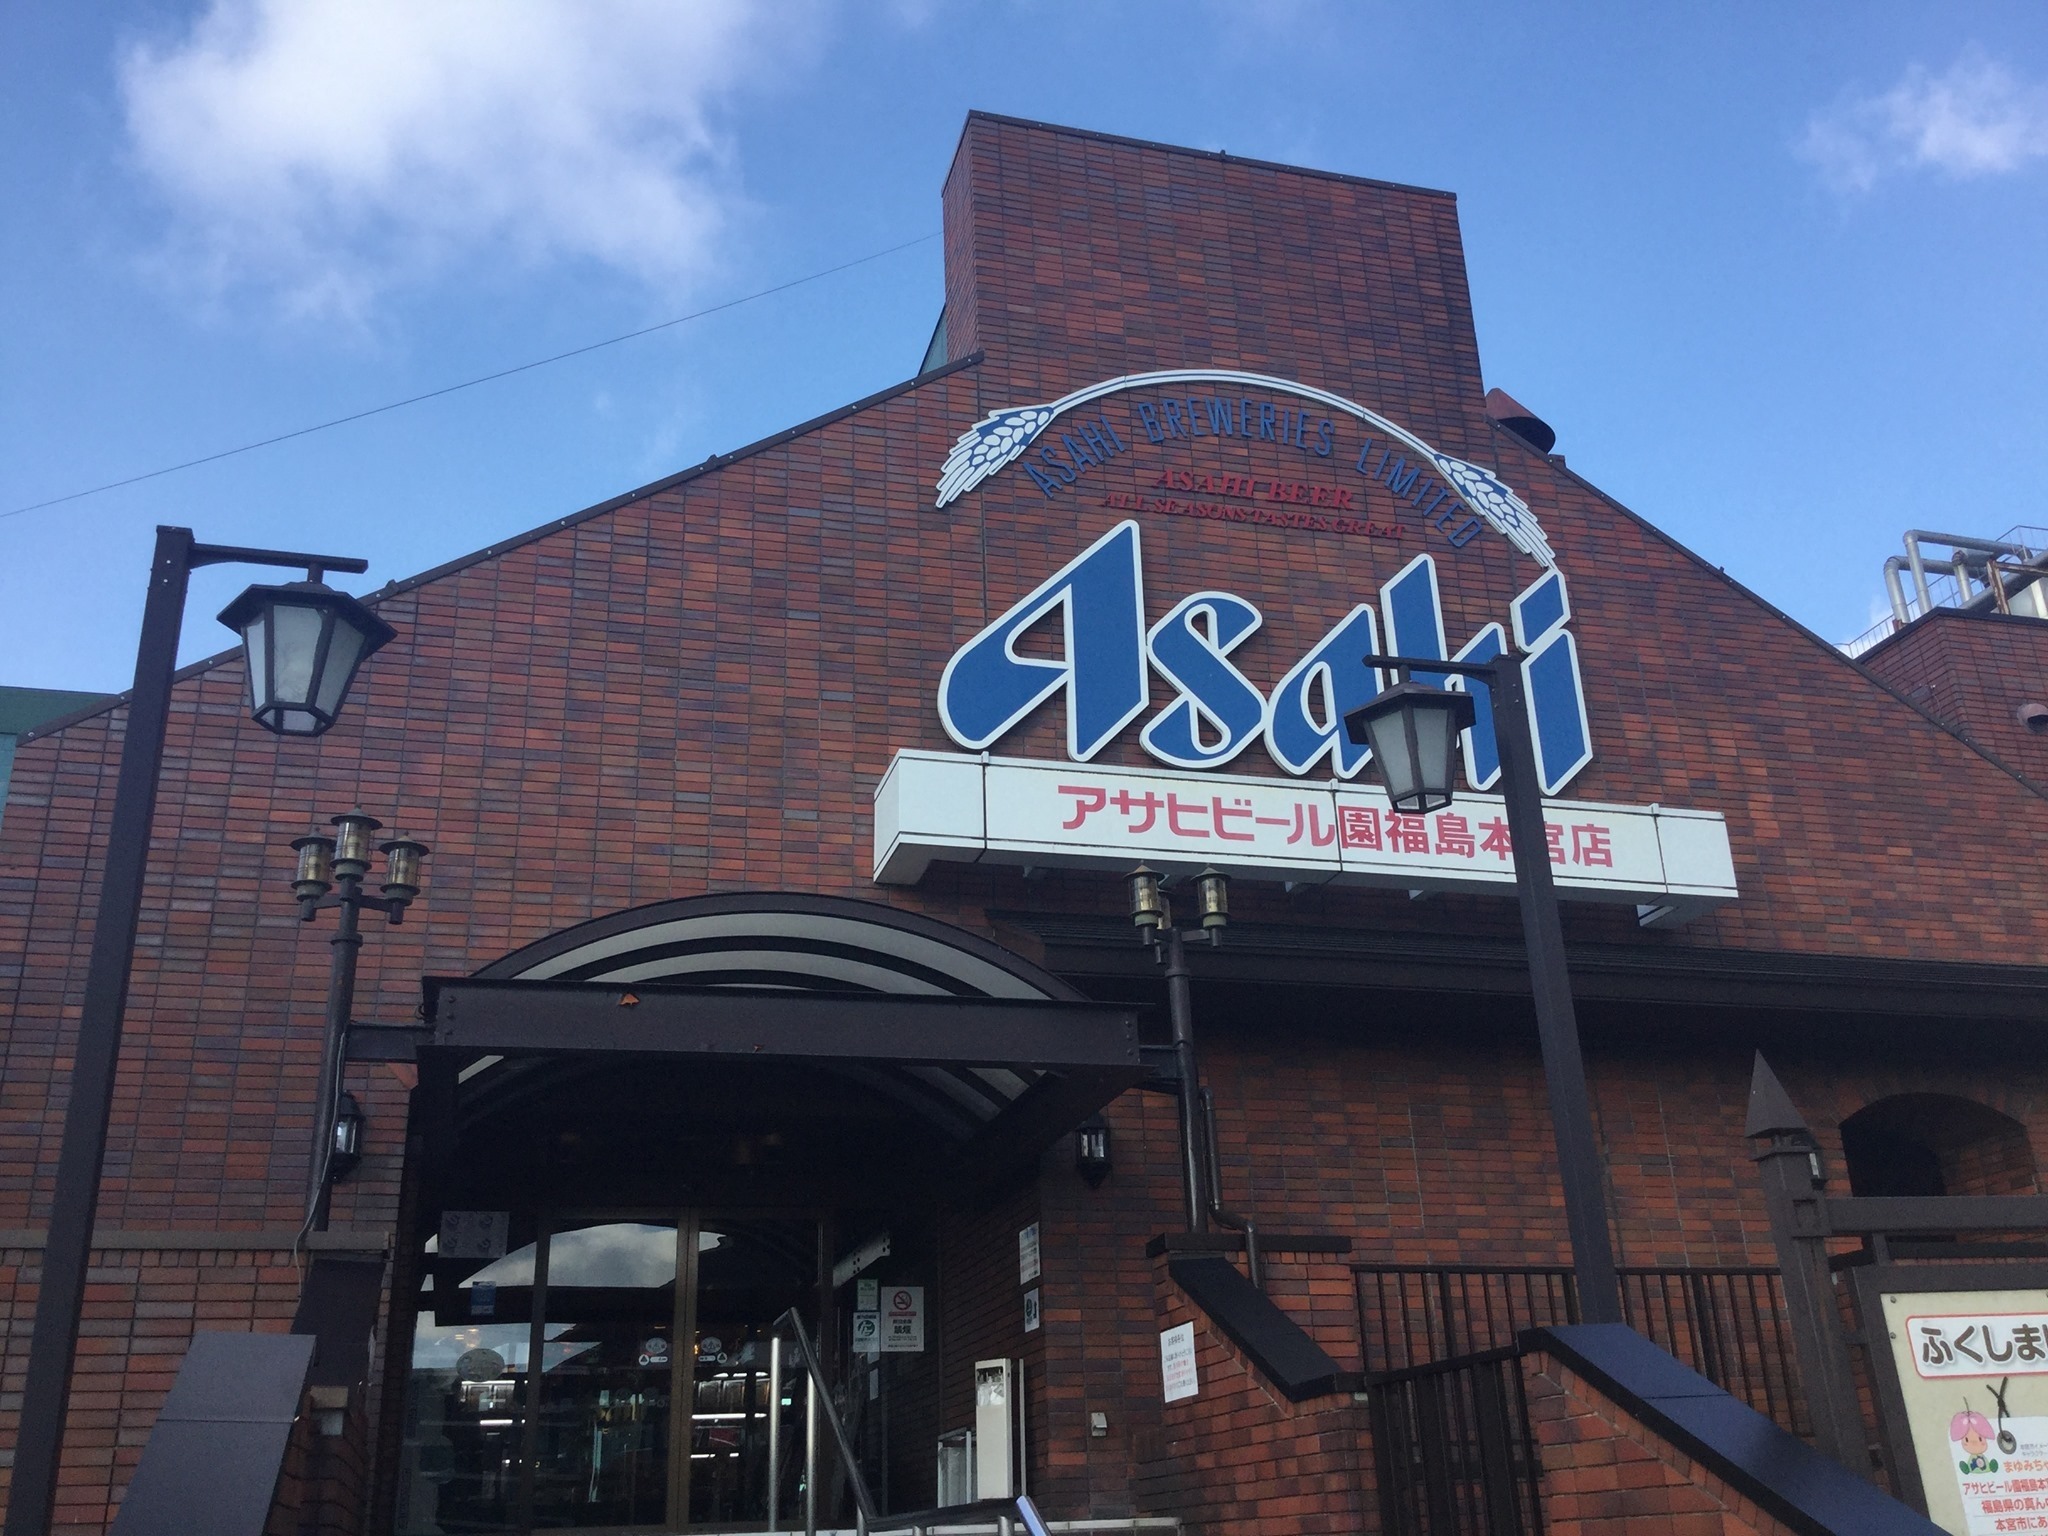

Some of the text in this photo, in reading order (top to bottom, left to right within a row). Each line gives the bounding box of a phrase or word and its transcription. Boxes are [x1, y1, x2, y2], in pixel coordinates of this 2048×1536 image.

[1022, 396, 1483, 548] ASAHI BREWERIES LIMITED
[1156, 468, 1354, 511] ASAHI BEER
[1103, 491, 1407, 540] ALL SEASONS TASTES GREAT
[937, 519, 1593, 796] Asahi
[1921, 1323, 2048, 1364] ふくしま
